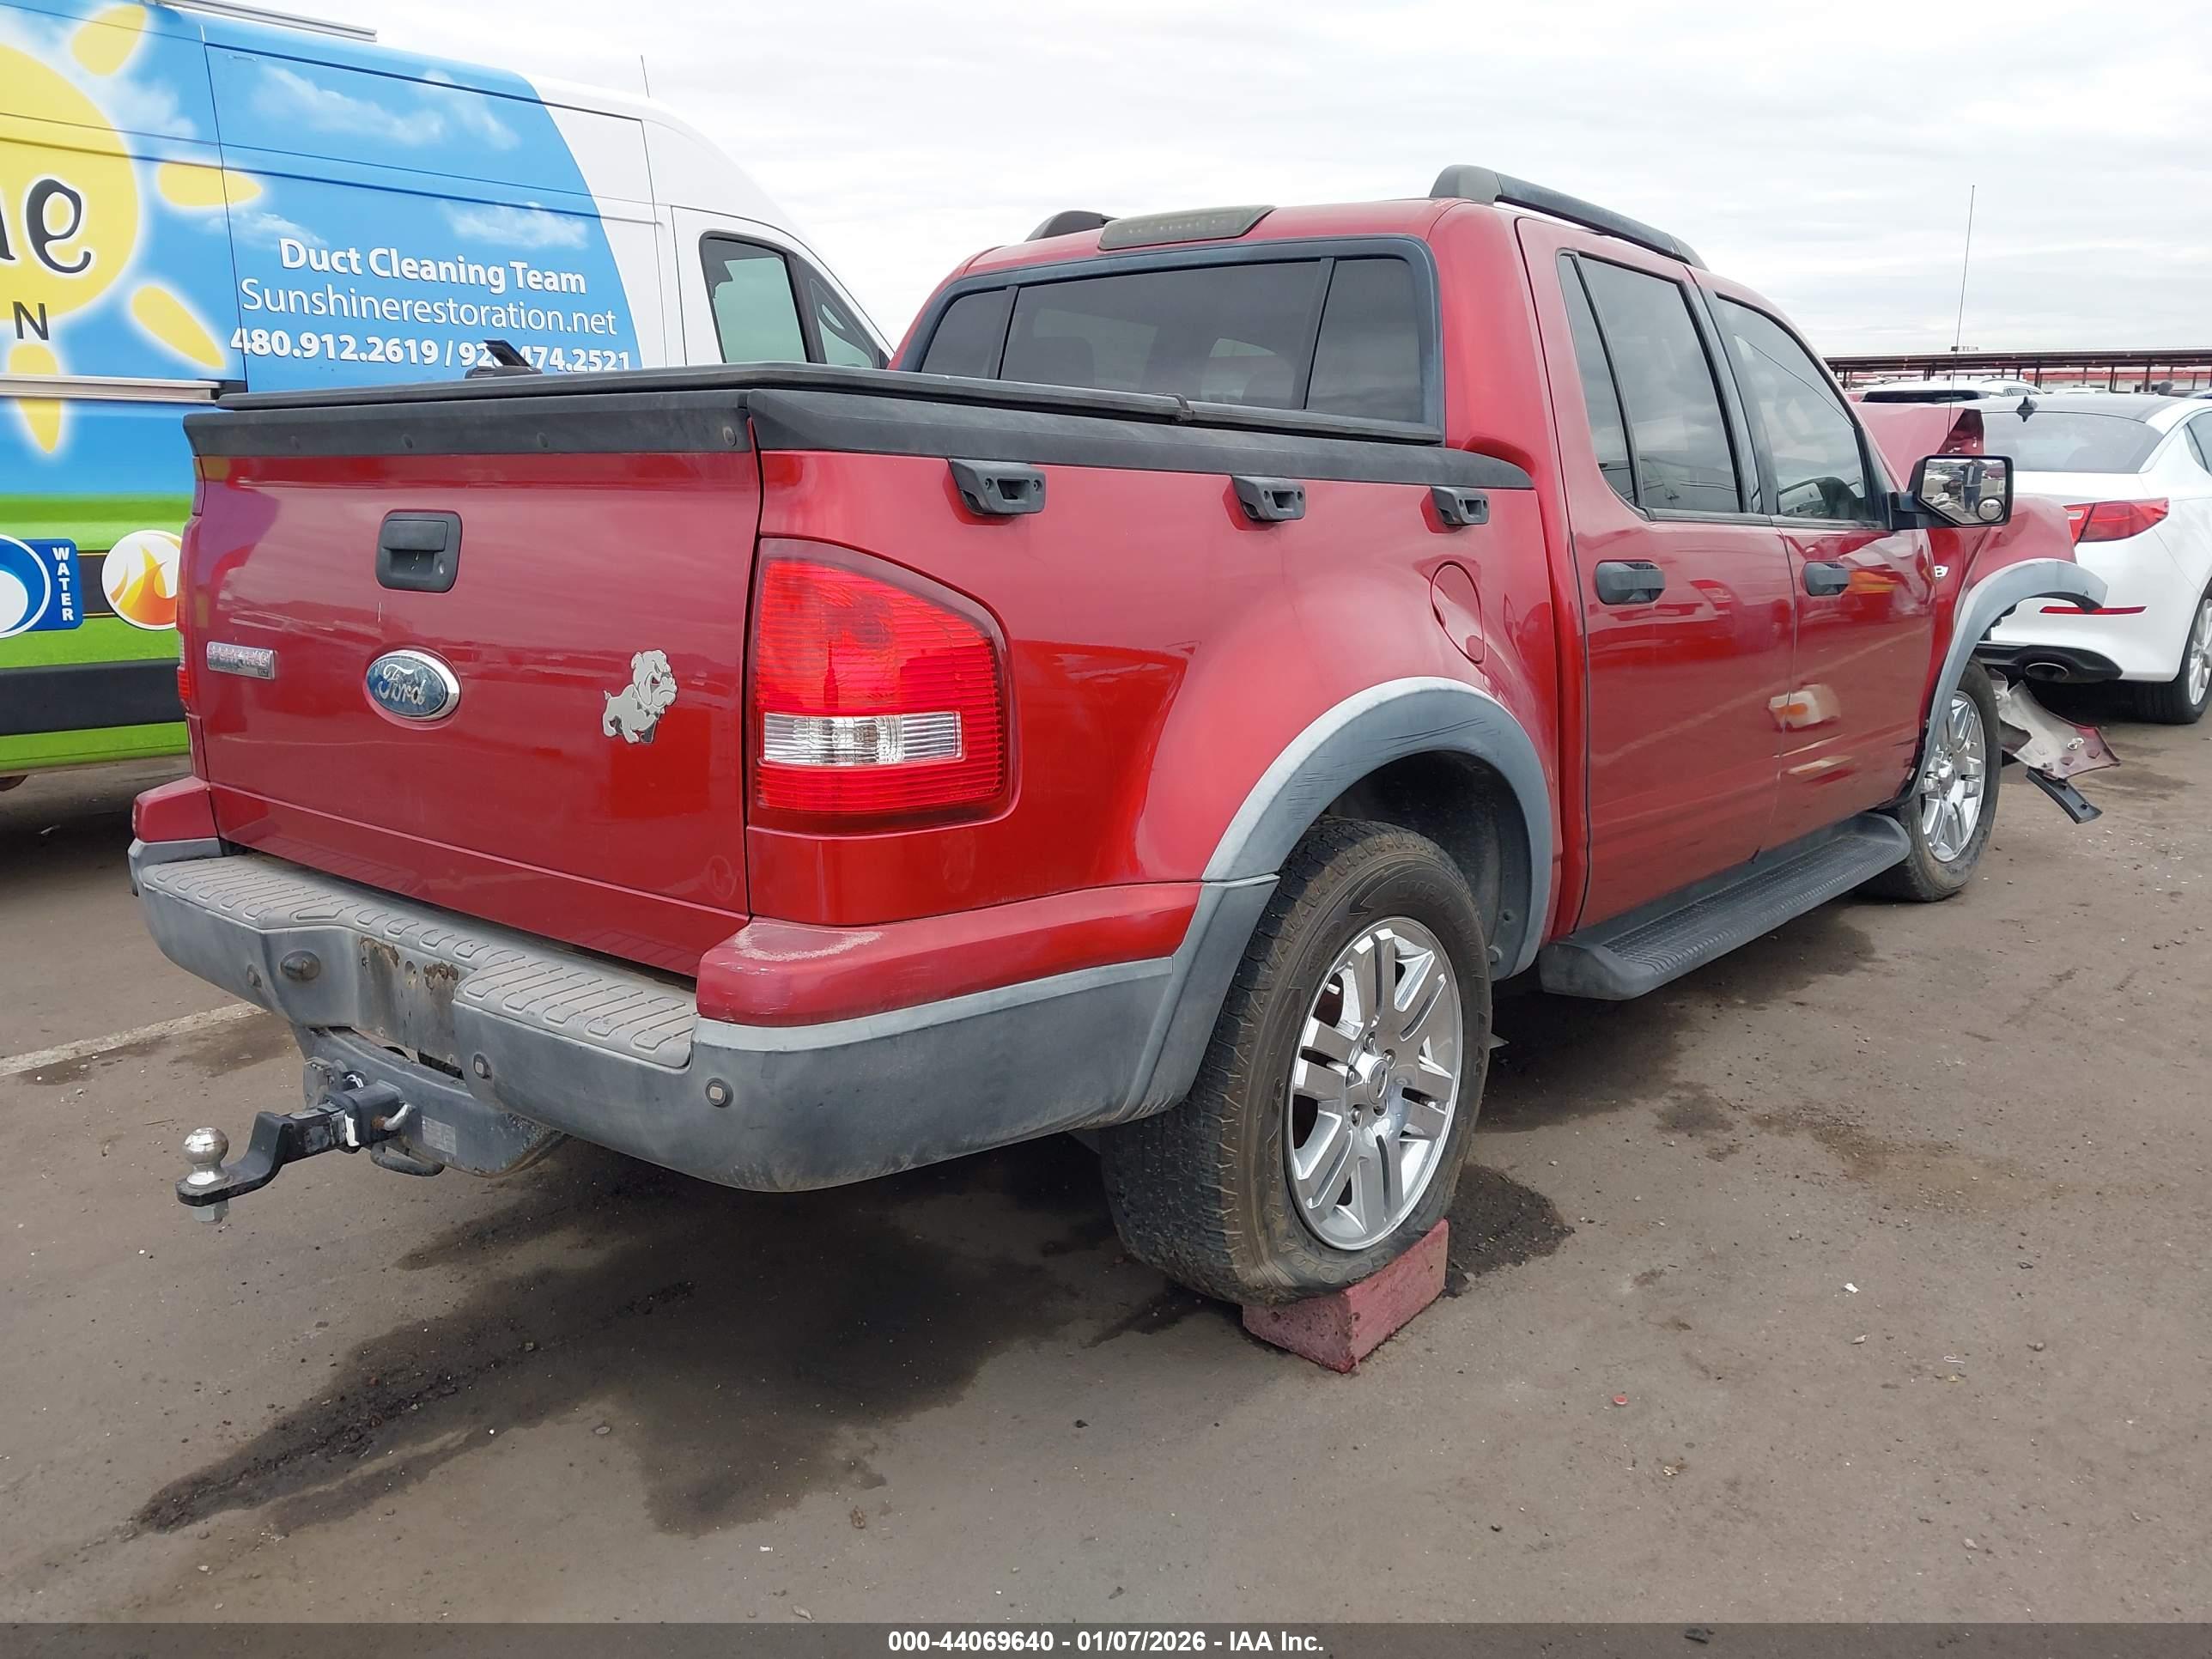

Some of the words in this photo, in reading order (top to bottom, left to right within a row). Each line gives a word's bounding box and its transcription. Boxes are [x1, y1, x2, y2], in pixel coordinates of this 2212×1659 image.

[278, 238, 362, 276] Duct
[368, 246, 507, 295] Cleaning
[508, 260, 586, 295] Team
[240, 276, 617, 336] Sunshinerestoration.net
[229, 325, 439, 366] 480.912.2619
[52, 547, 75, 622] WATER
[378, 663, 427, 706] Ford
